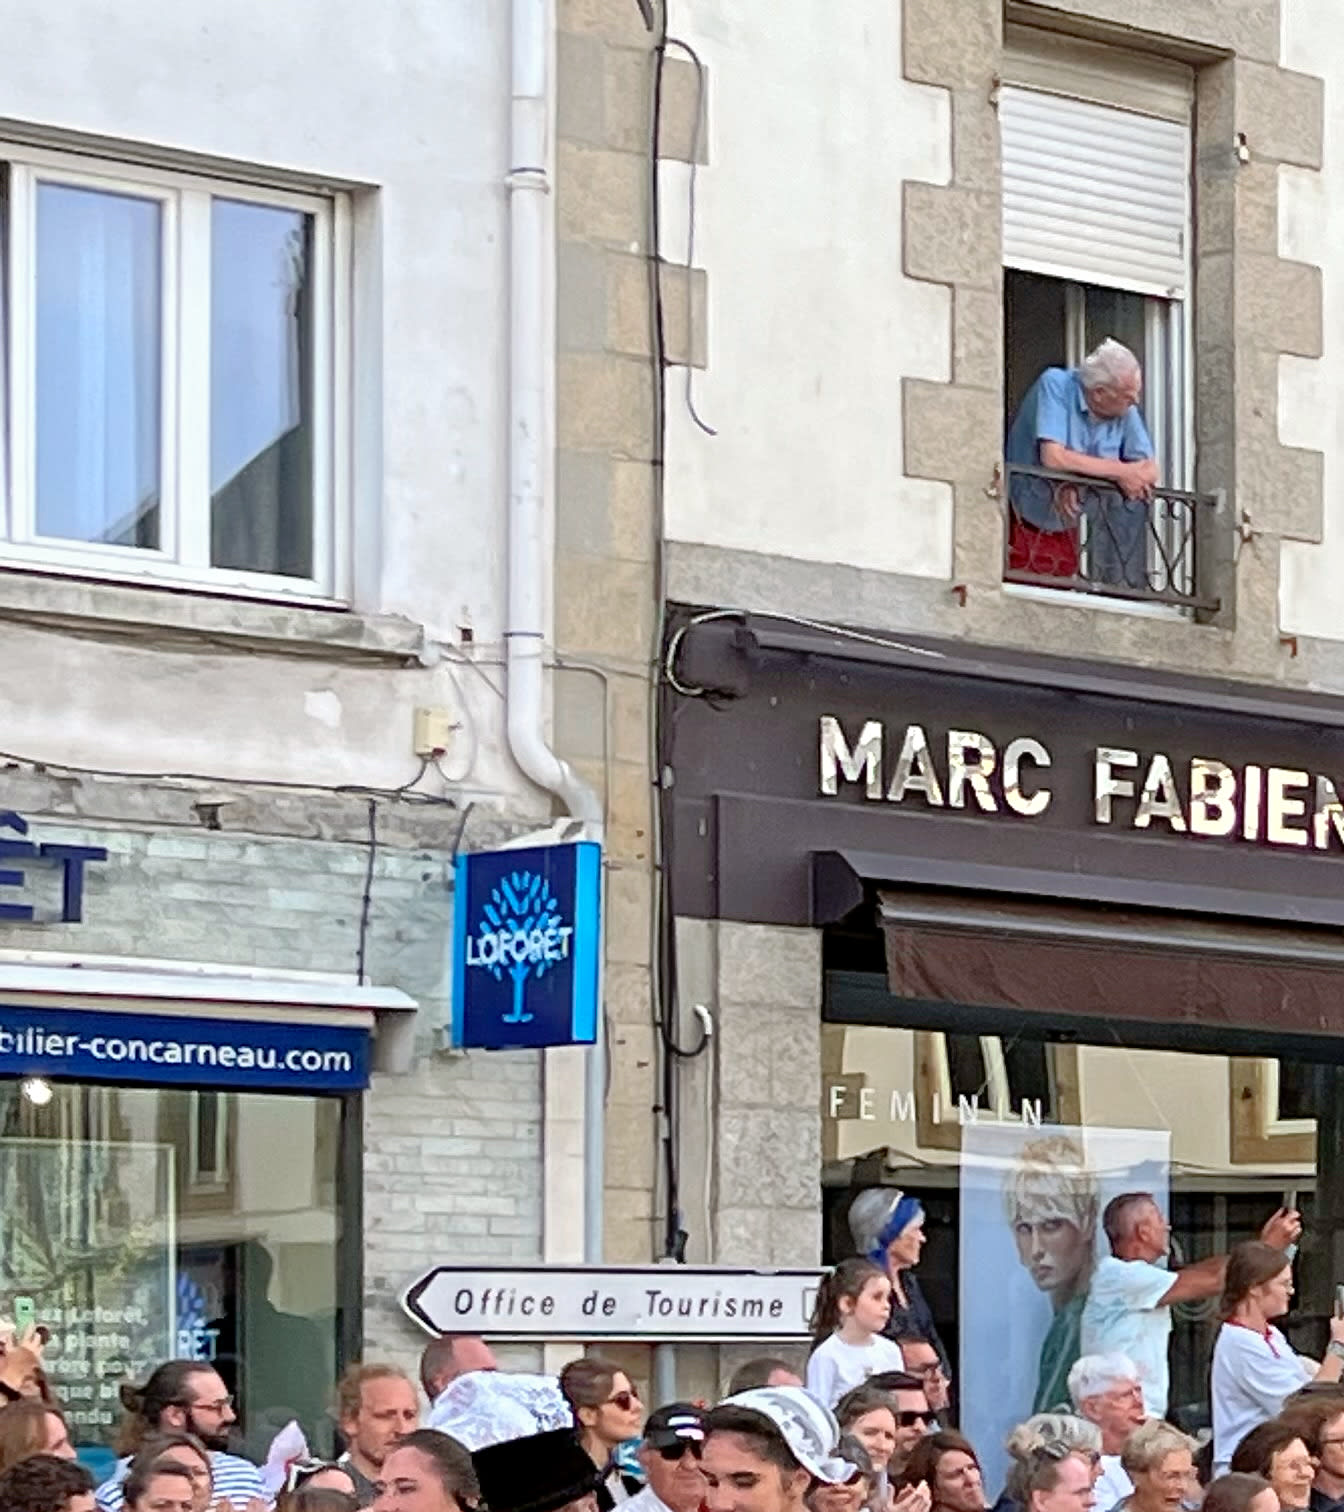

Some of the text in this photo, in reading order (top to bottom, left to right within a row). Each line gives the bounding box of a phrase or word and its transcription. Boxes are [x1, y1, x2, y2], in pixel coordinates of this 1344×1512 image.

[818, 713, 1052, 816] MARC
[453, 1288, 784, 1318] Office de Tourisme
